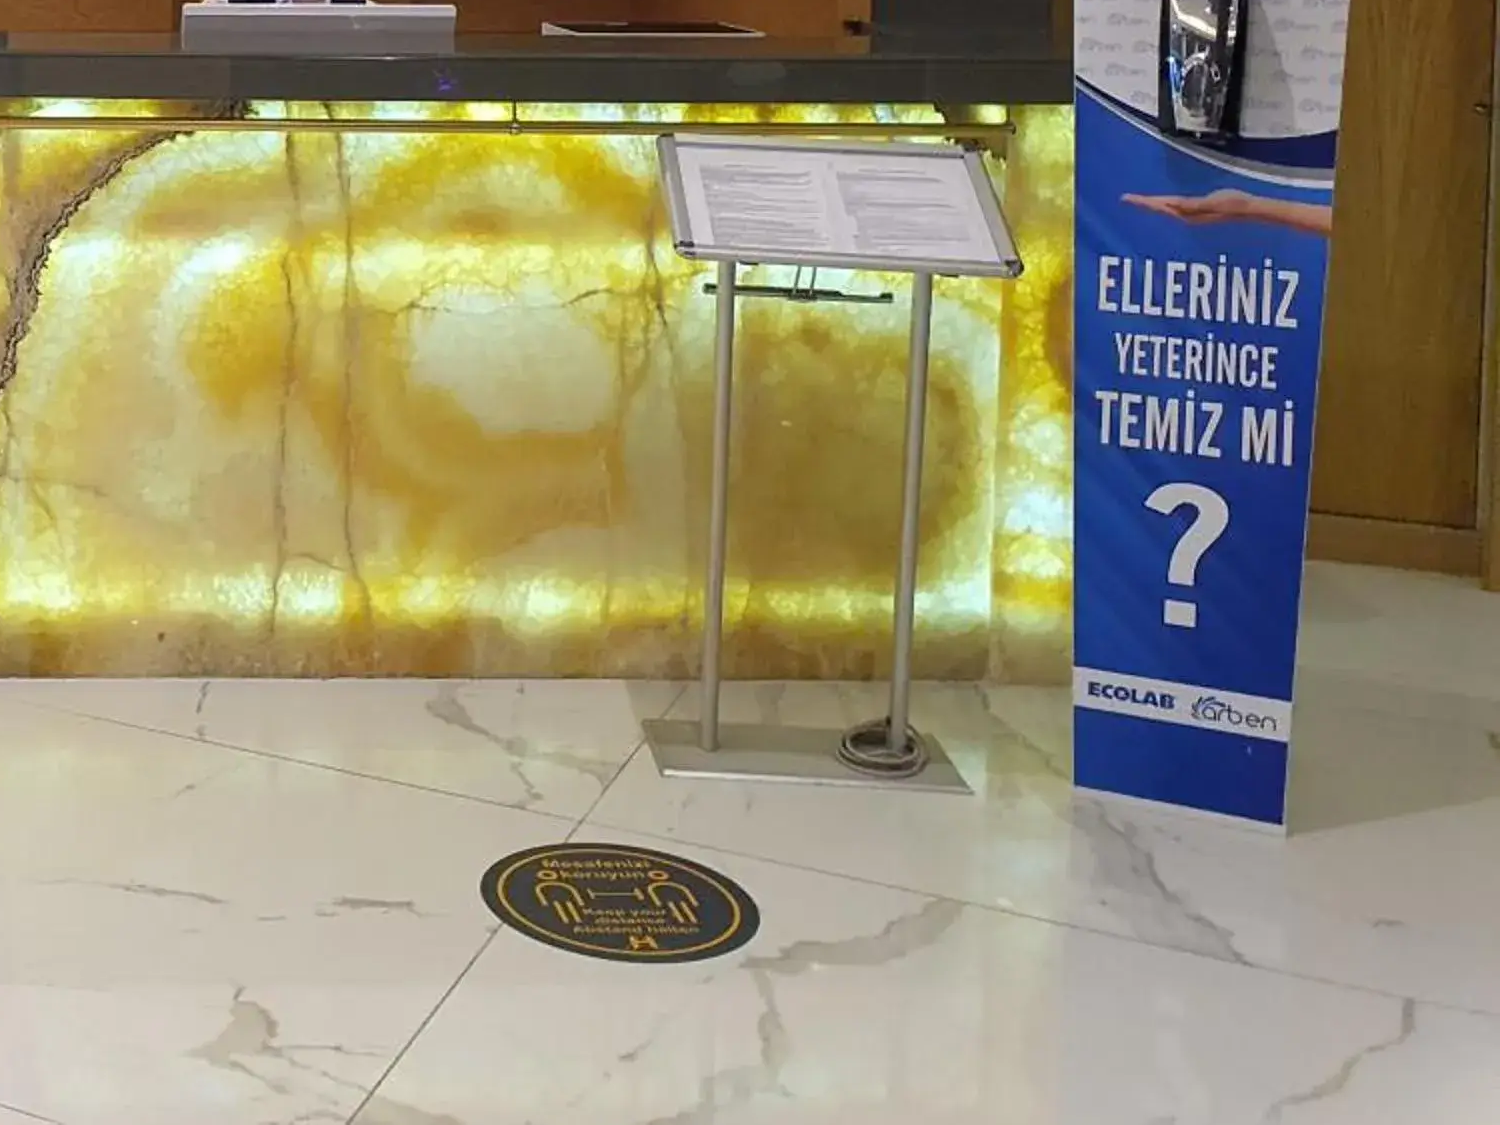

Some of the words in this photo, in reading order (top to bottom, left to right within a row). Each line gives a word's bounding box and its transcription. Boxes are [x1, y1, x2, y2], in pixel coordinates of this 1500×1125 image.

[1098, 254, 1299, 328] ELLERİNİZ
[1114, 332, 1278, 390] YETERİNCE
[1095, 389, 1223, 458] TEMİZ
[1241, 400, 1293, 467] Mİ
[1144, 482, 1229, 628] ?
[1087, 682, 1176, 710] ECOLAB
